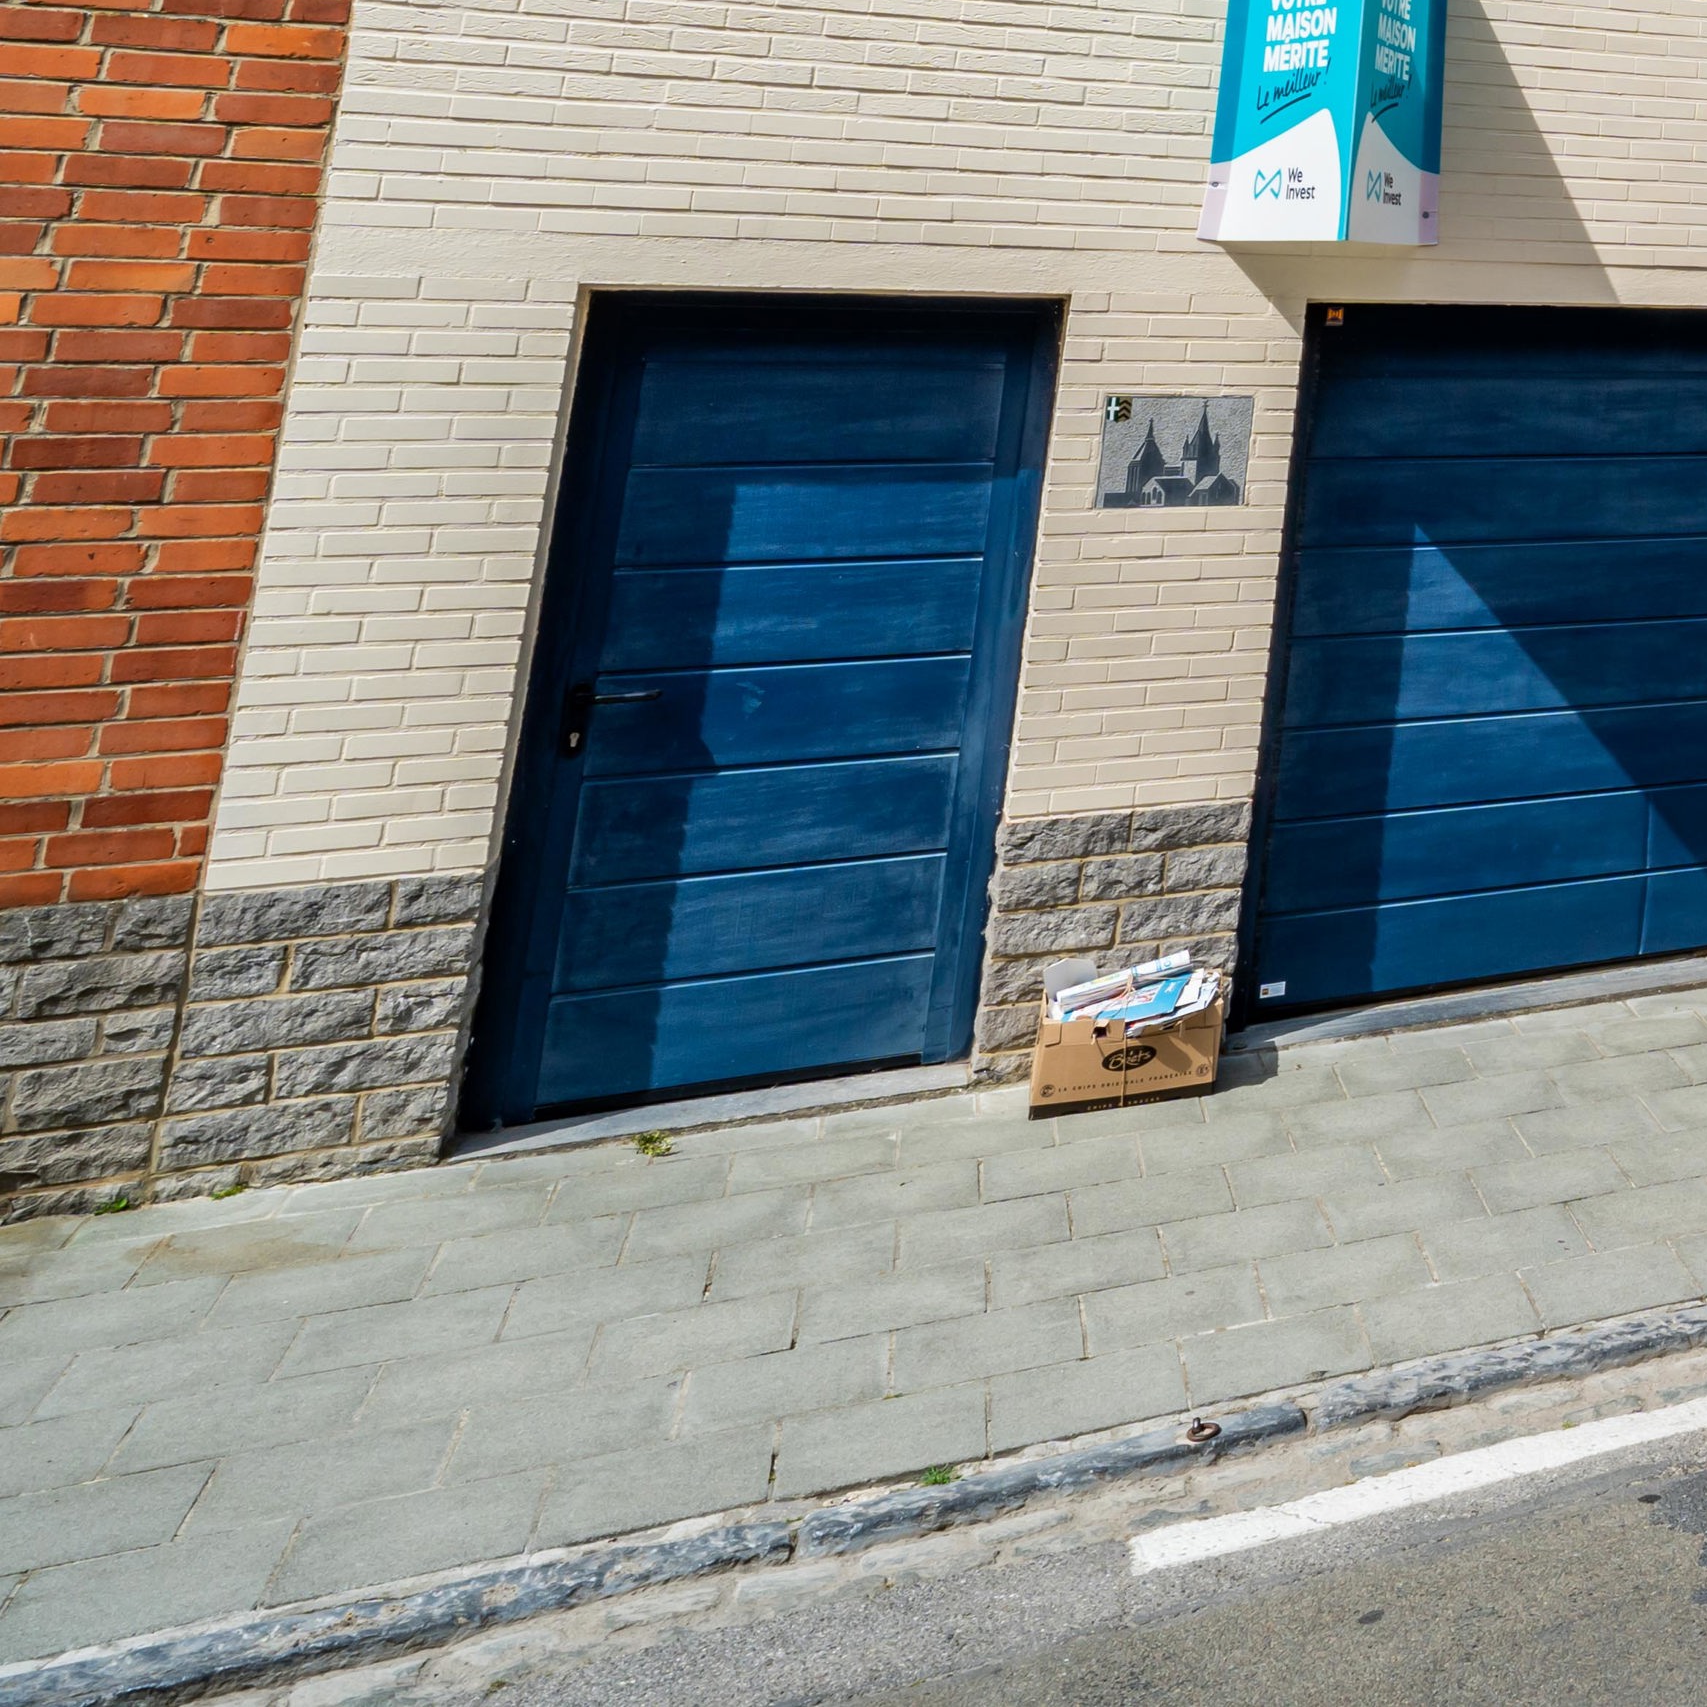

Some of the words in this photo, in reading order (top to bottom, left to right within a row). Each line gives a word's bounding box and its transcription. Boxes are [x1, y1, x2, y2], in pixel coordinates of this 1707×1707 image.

[1266, 7, 1338, 42] MAISON
[1377, 12, 1417, 53] MAISON
[1263, 36, 1330, 73] MÉRITE
[1374, 39, 1411, 82] MÉRITE
[1257, 85, 1270, 110] Le
[1287, 167, 1304, 183] We
[1384, 172, 1394, 189] We
[1285, 185, 1316, 200] Invest
[1383, 189, 1402, 206] Invest
